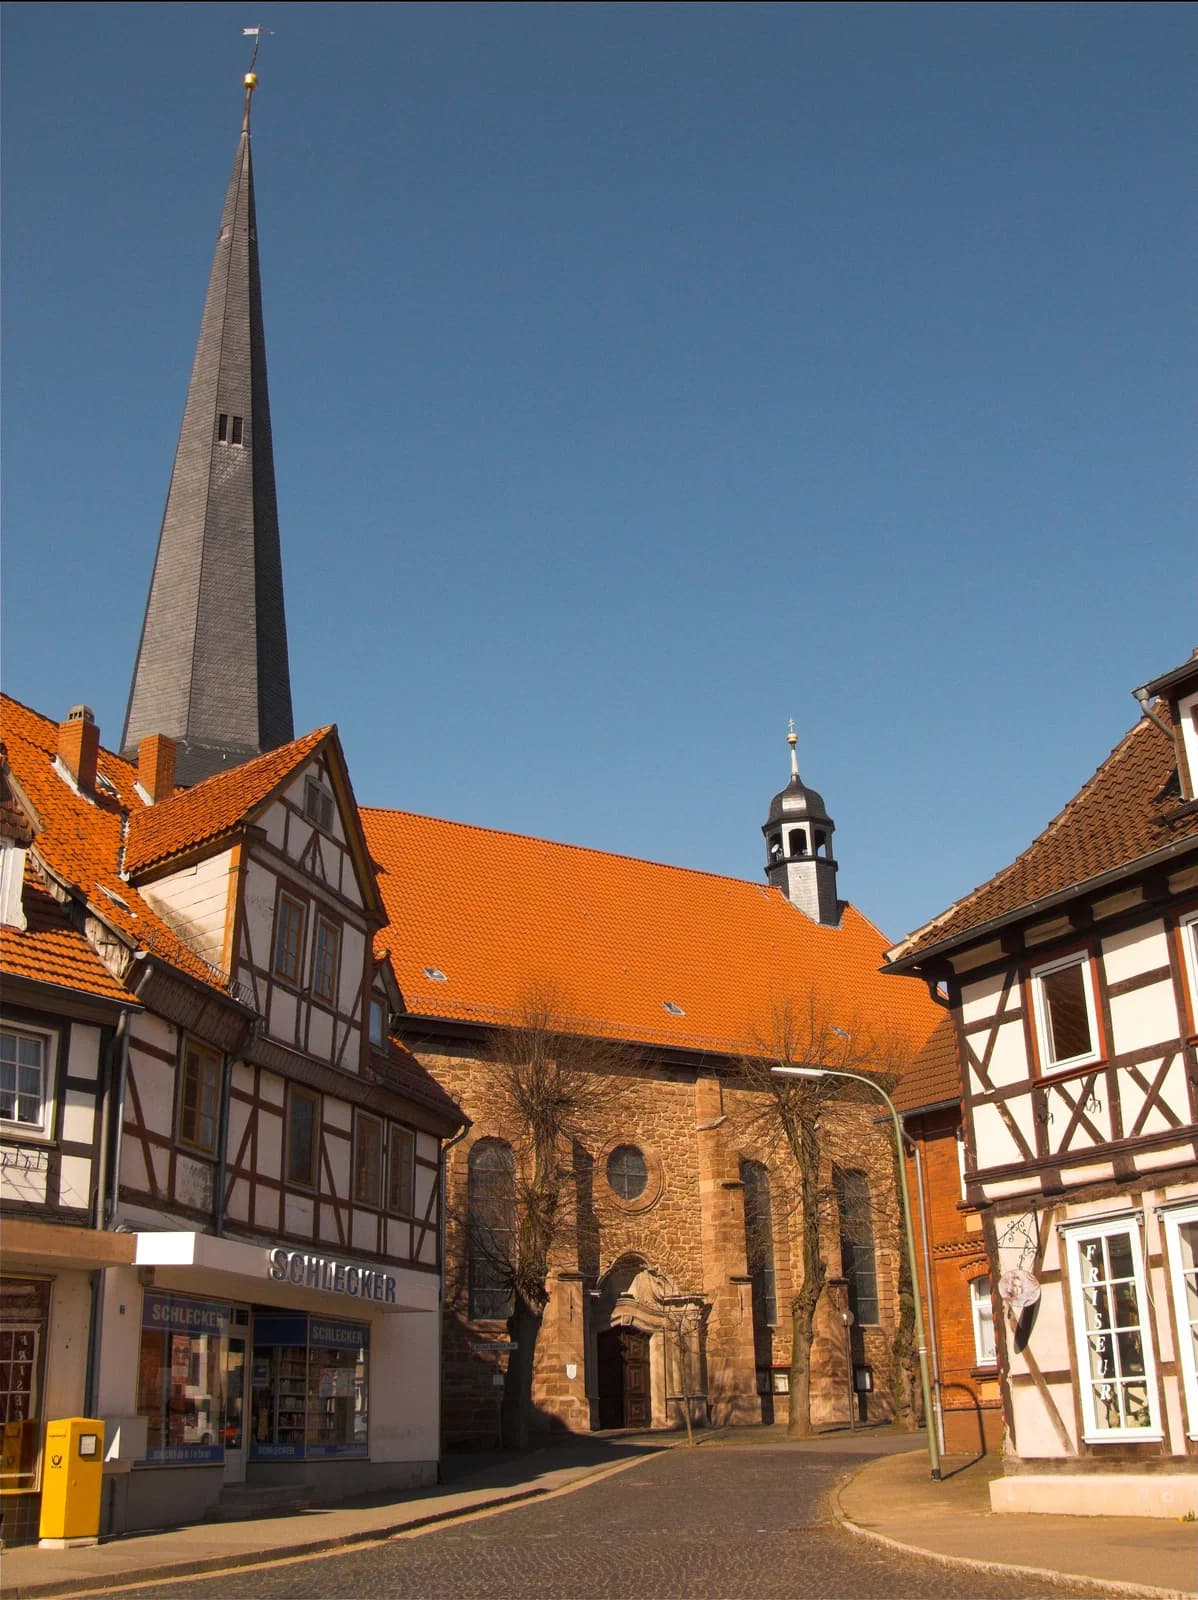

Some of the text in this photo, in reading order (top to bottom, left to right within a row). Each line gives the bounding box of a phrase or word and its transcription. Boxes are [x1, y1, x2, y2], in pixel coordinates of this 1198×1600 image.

[268, 1248, 396, 1303] SCHLECKER
[152, 1304, 223, 1328] SCHLECKER
[312, 1326, 362, 1344] SCHLECKER
[1086, 1245, 1111, 1400] FRISEUR
